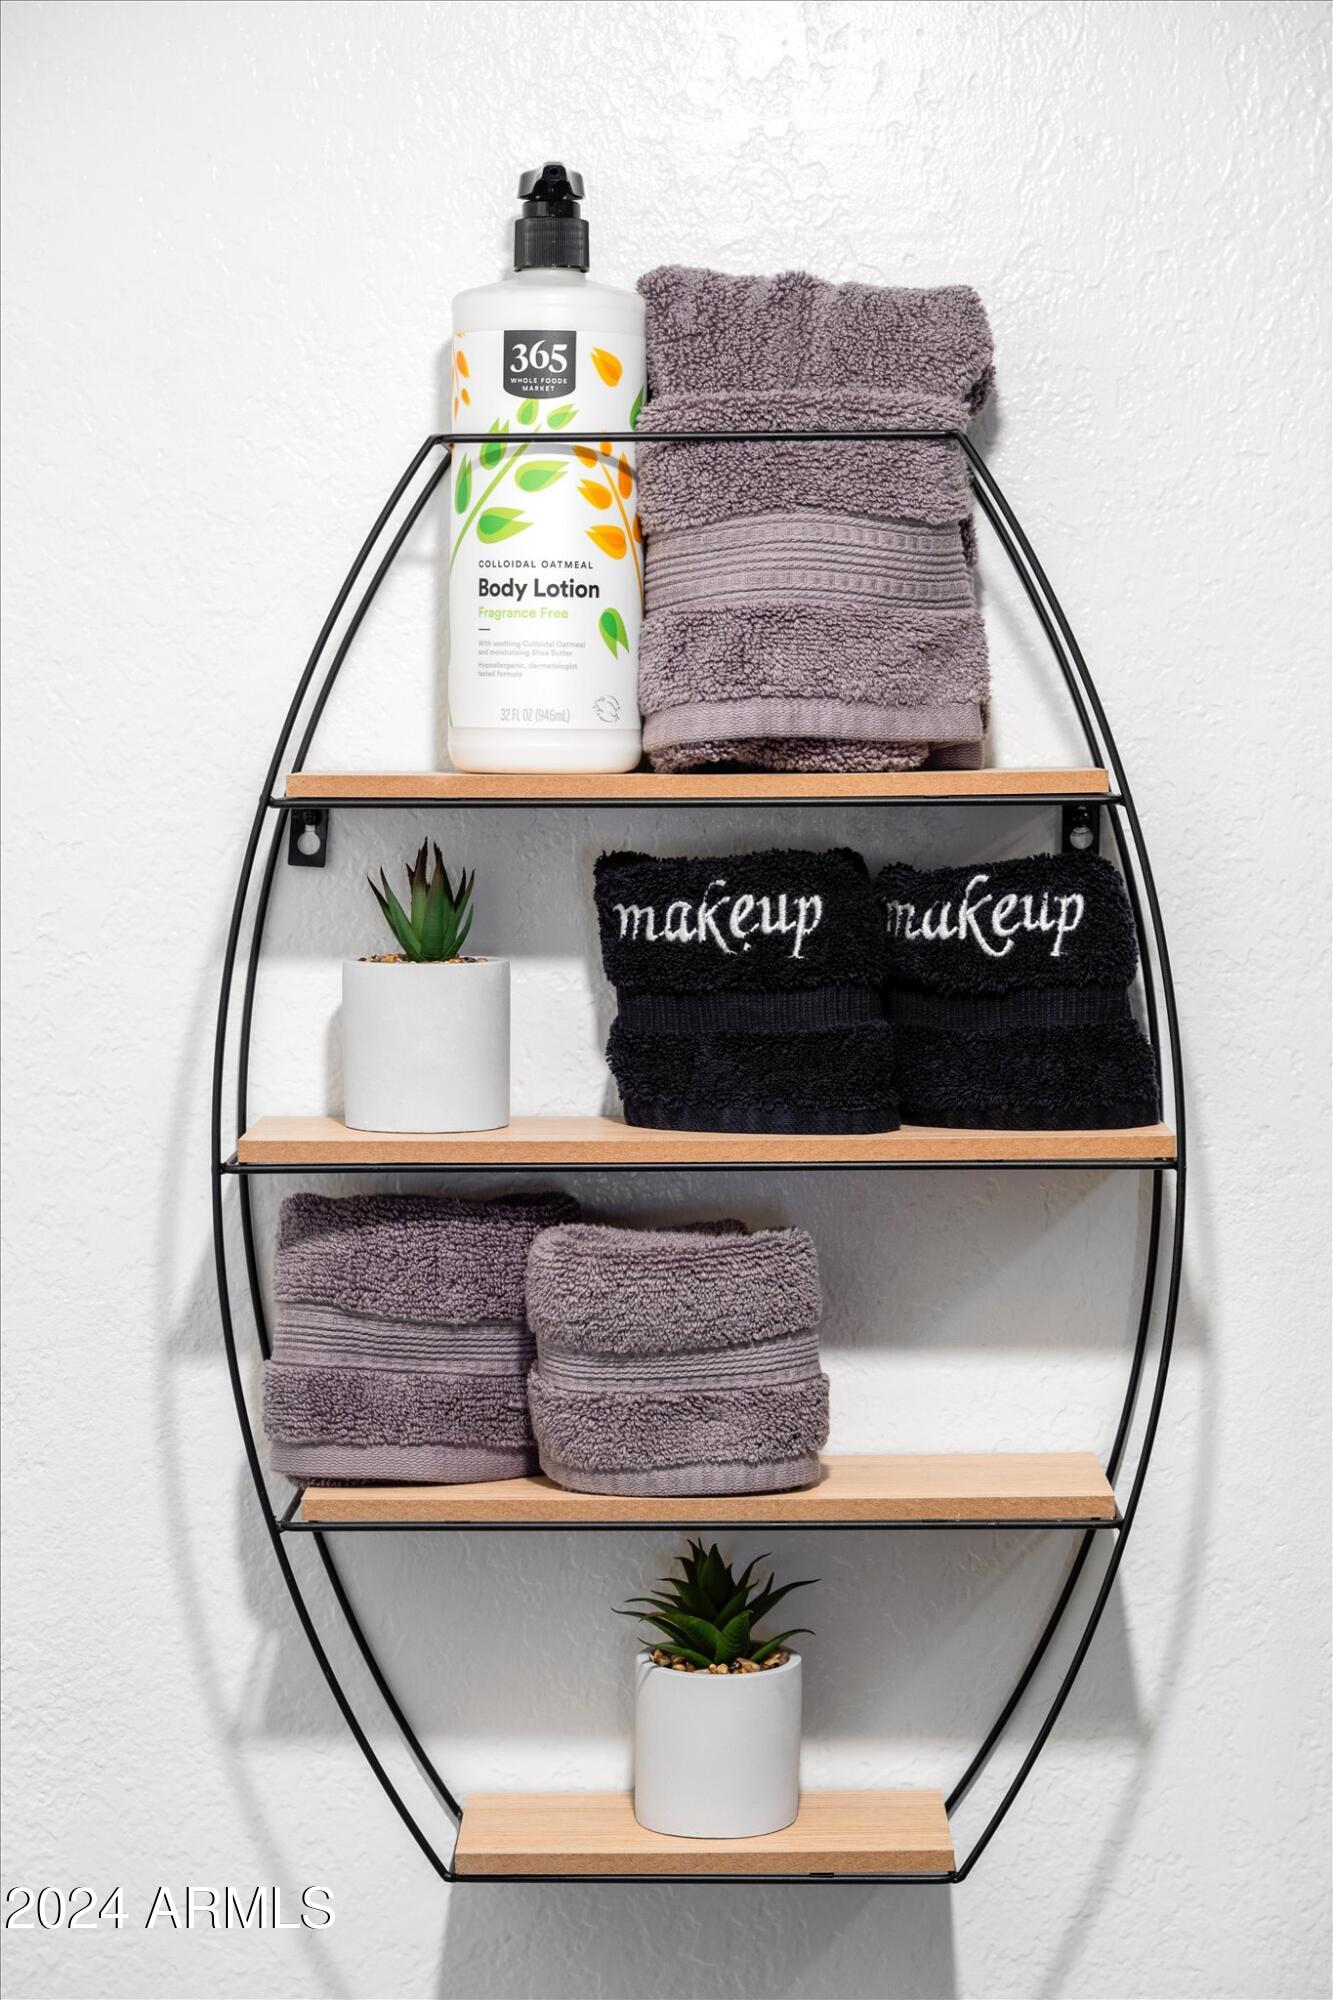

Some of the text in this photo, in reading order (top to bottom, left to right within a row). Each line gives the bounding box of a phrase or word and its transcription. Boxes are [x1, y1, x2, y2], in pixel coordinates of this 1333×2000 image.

[510, 339, 568, 373] 365
[510, 377, 568, 385] WHOLE FOODS
[478, 560, 594, 570] COLLOIDAL OATMEAL
[478, 578, 600, 602] Body Lotion
[478, 606, 569, 621] Fragrance Free
[500, 707, 571, 724] 32 FL OZ (946mL)
[613, 879, 823, 958] makeup
[886, 874, 1084, 957] makeup
